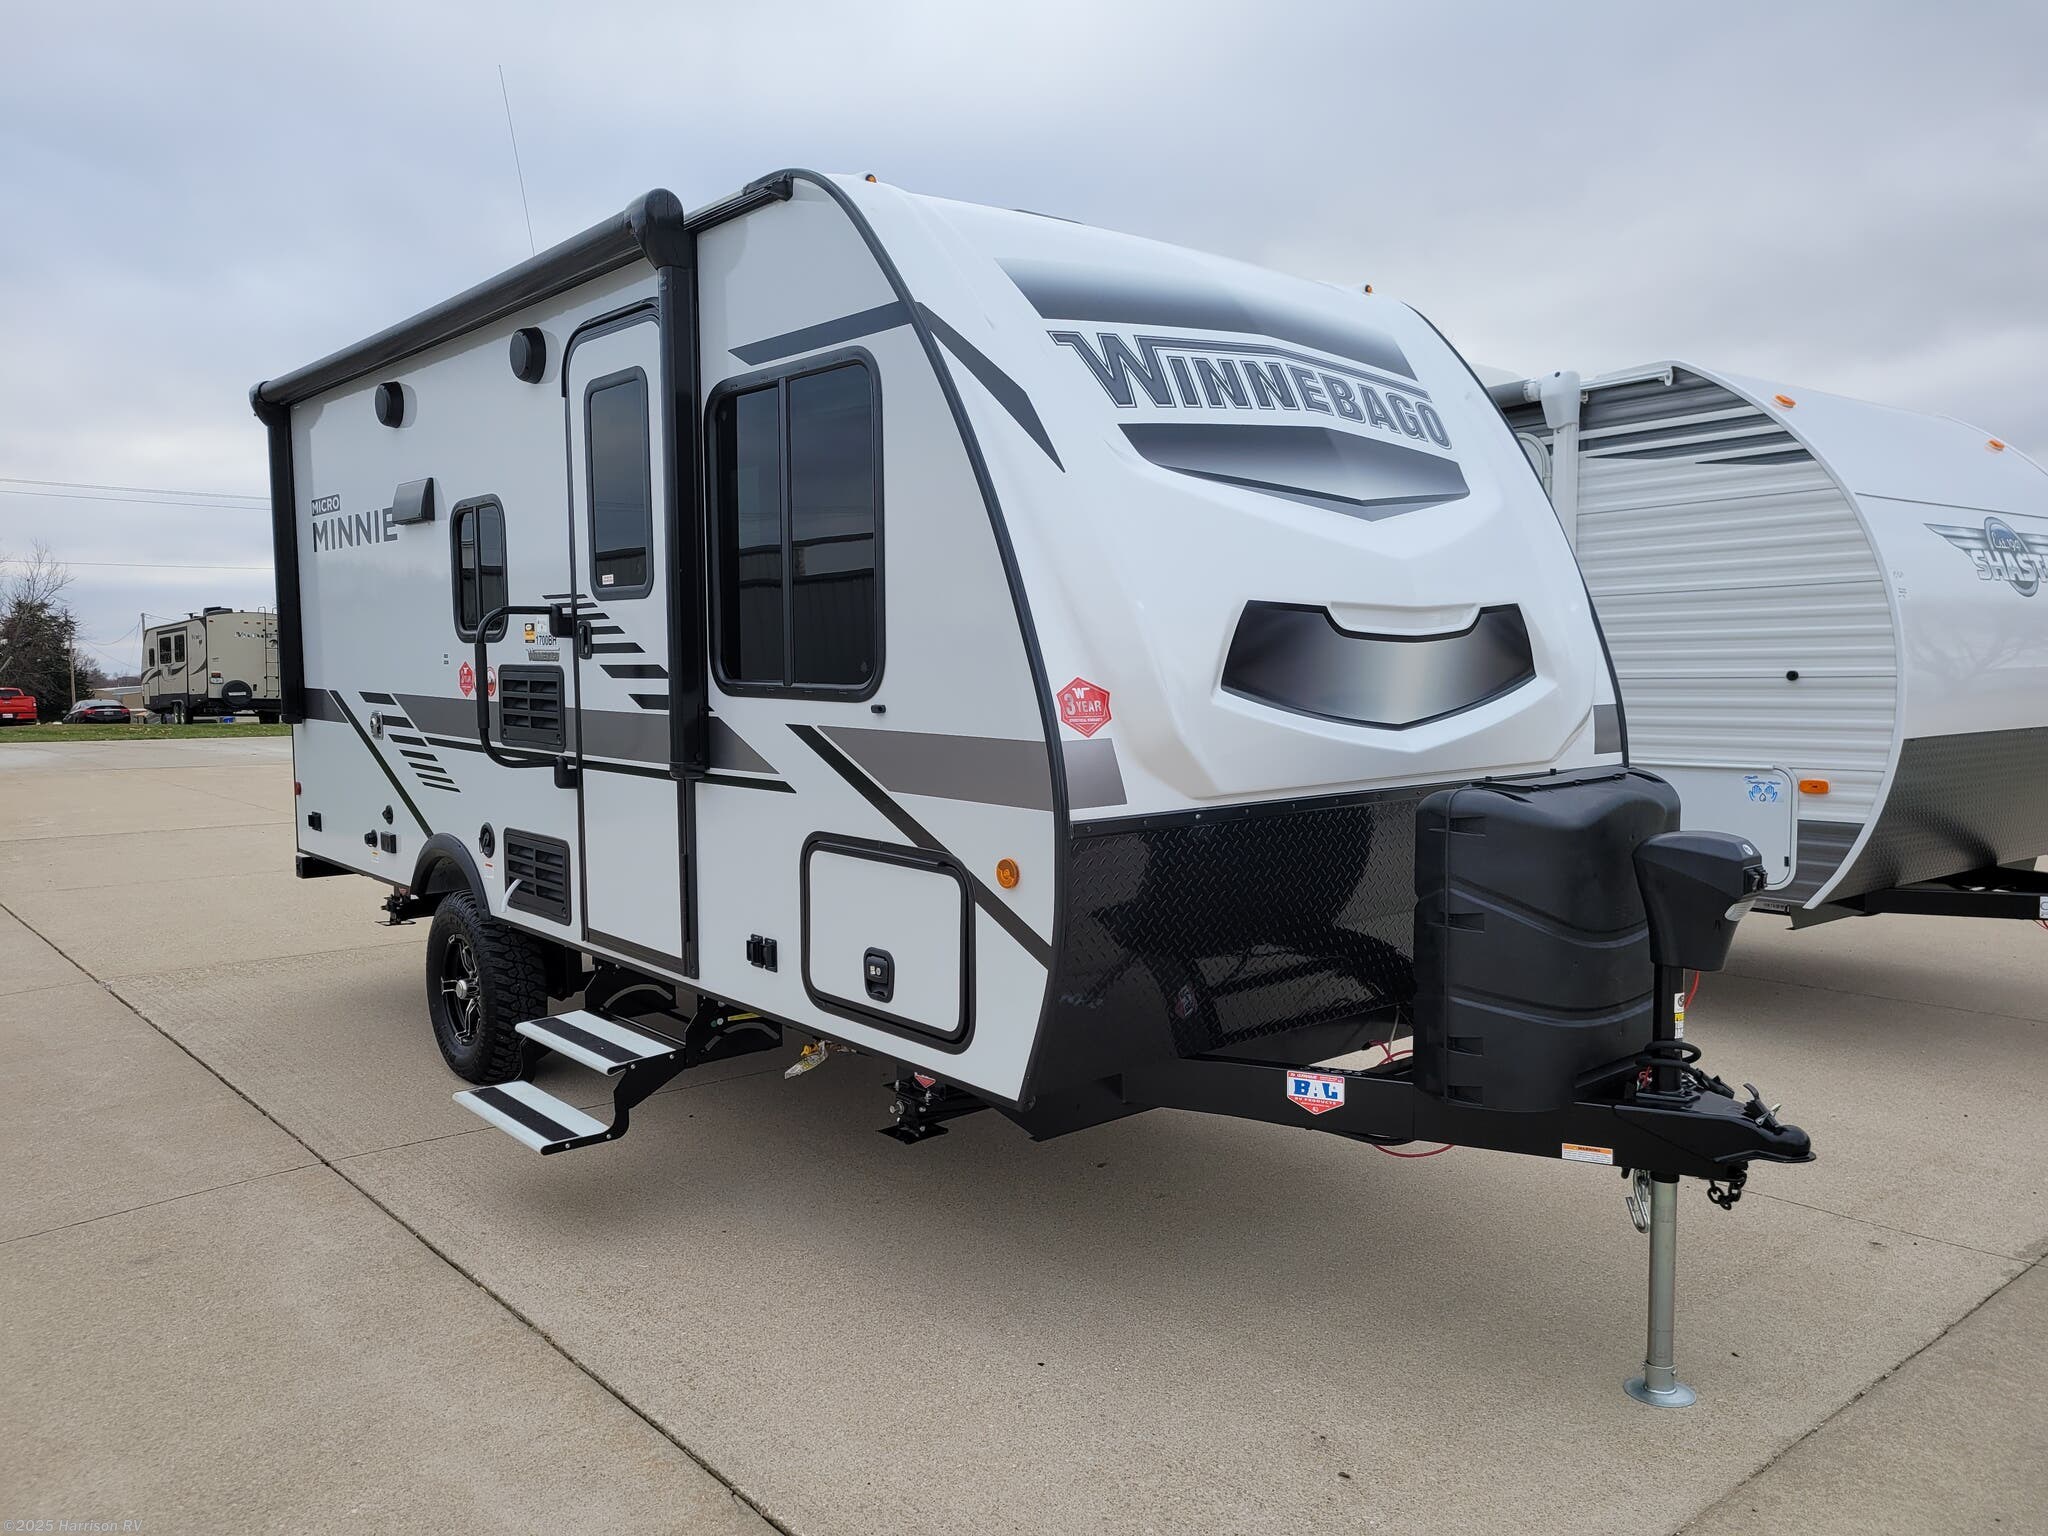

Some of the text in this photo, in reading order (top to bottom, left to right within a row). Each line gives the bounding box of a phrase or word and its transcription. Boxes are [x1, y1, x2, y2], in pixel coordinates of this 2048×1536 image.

[1046, 330, 1452, 450] WINNEBAGO
[312, 496, 340, 515] MICRO
[312, 507, 398, 552] MINNIE
[1063, 693, 1102, 716] 3 YEAR
[1293, 1078, 1338, 1100] BAL
